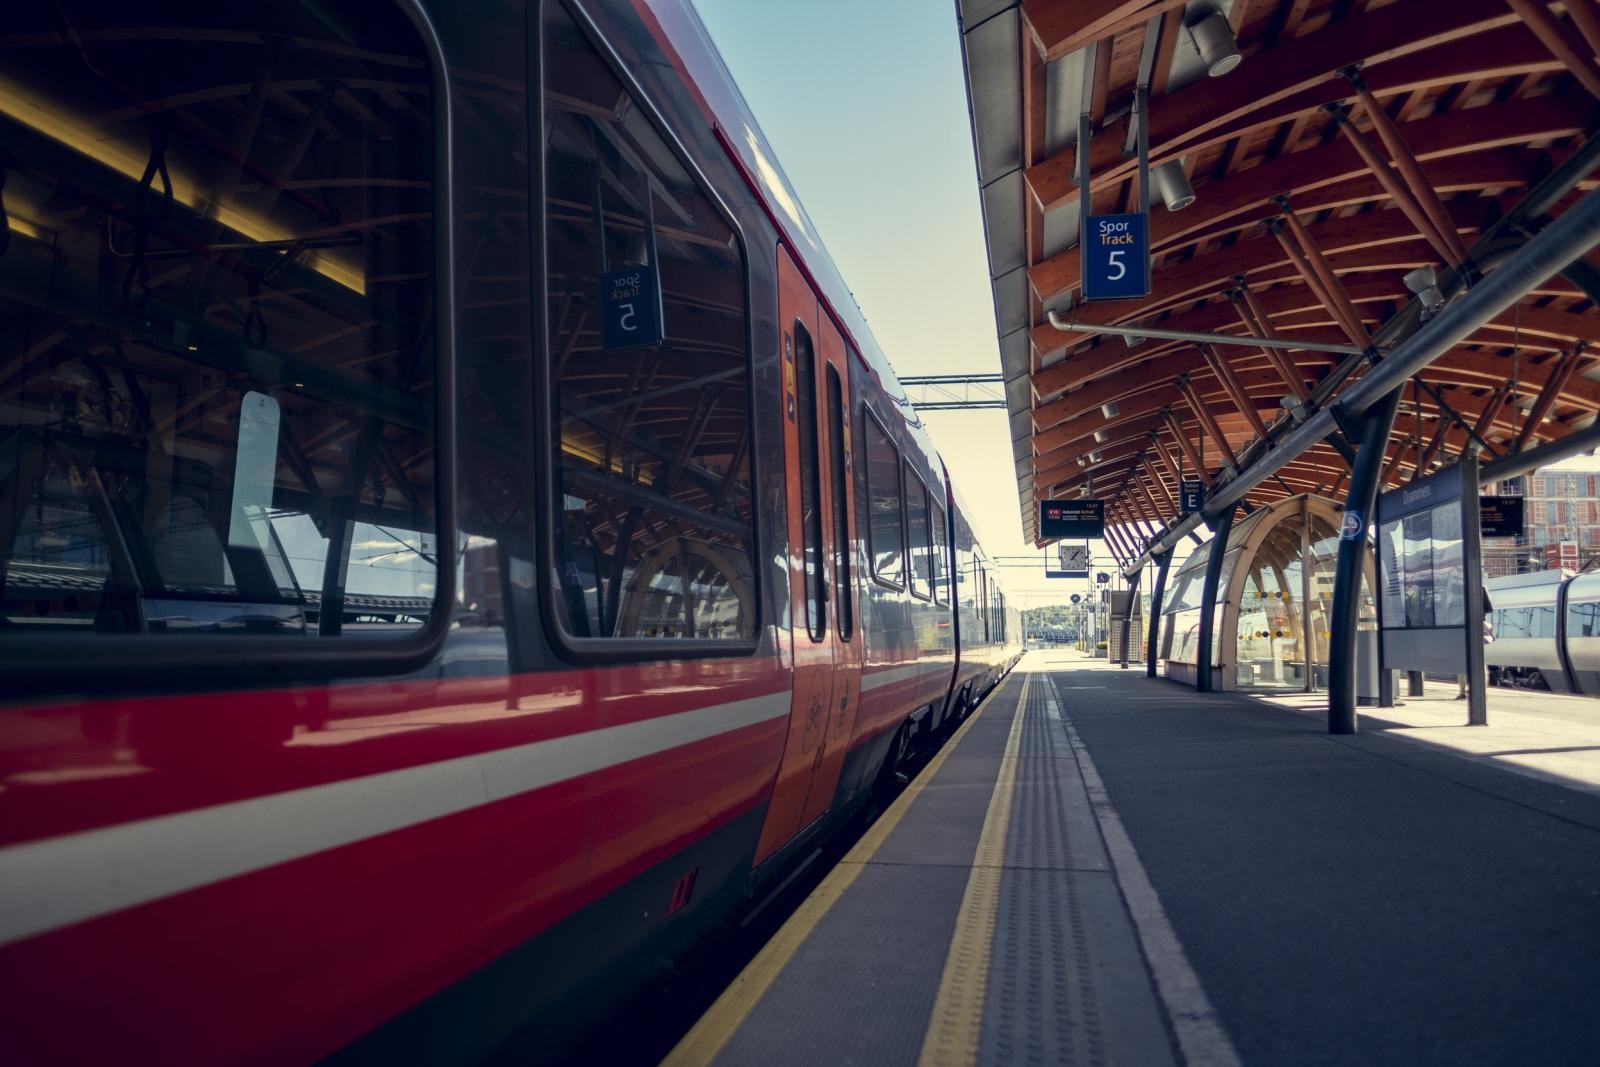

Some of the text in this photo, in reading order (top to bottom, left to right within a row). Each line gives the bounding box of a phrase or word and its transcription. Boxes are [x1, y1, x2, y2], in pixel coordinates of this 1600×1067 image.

[1099, 220, 1129, 234] Spor
[1099, 232, 1134, 245] Track
[1107, 250, 1126, 280] 5
[1188, 494, 1197, 508] E
[1402, 484, 1430, 505] Drammen
